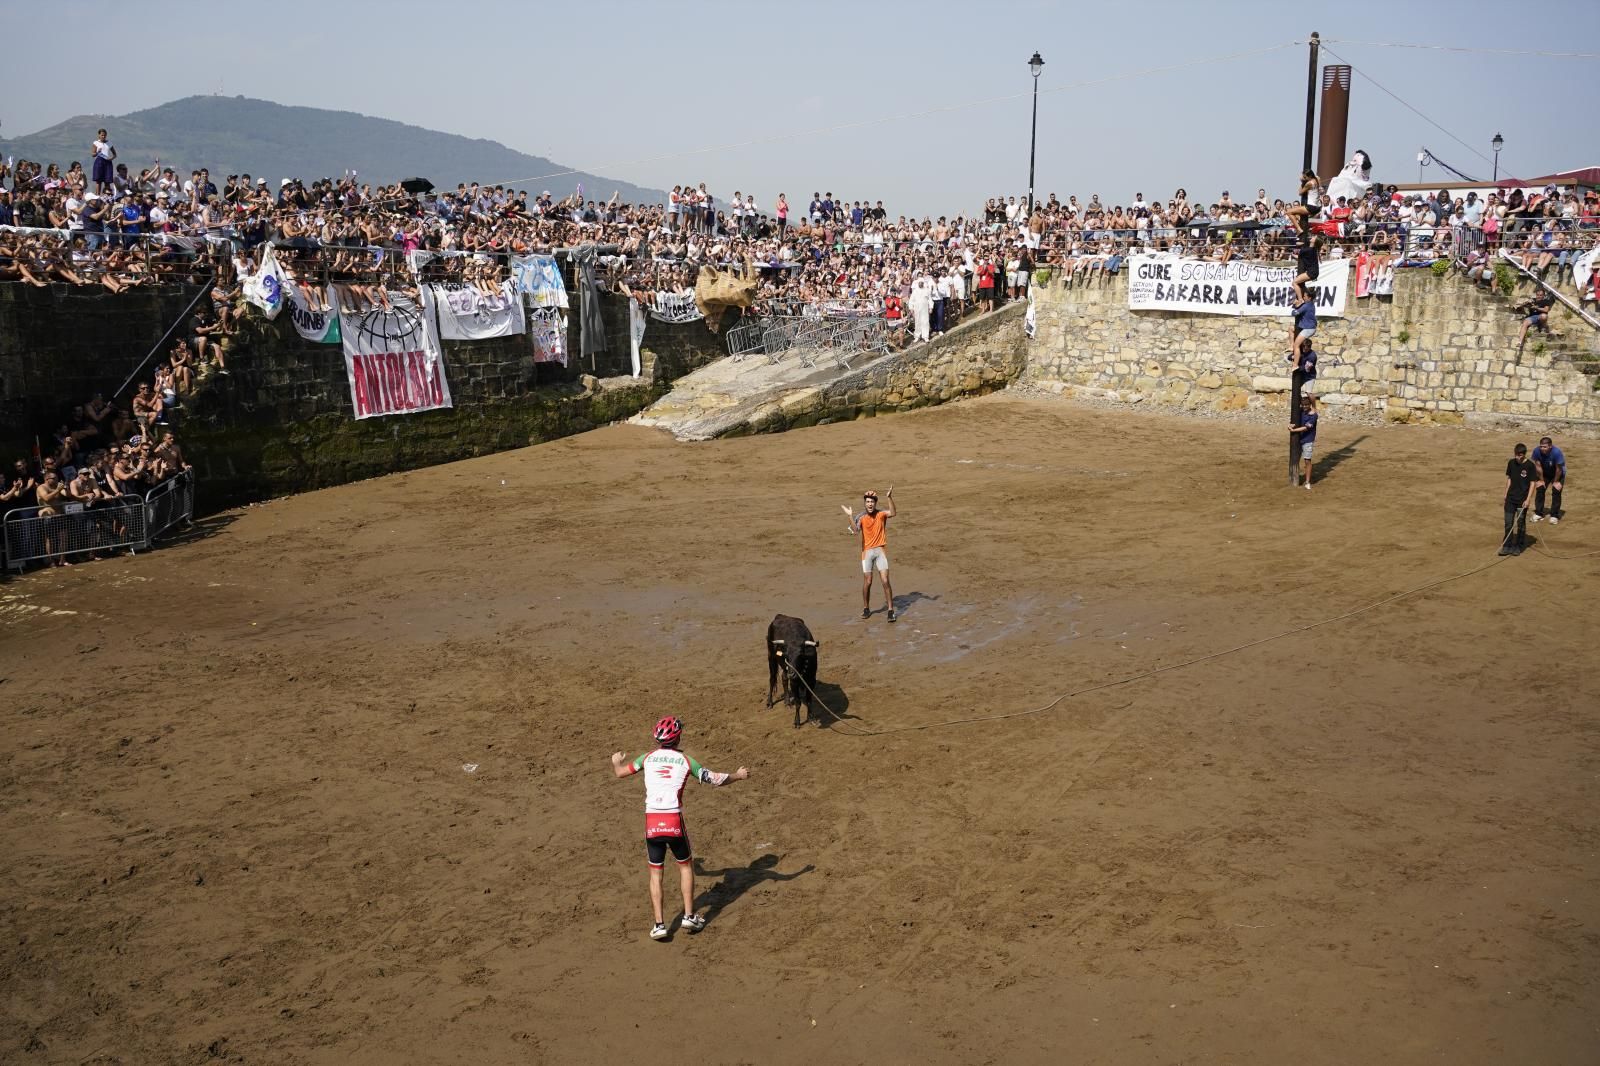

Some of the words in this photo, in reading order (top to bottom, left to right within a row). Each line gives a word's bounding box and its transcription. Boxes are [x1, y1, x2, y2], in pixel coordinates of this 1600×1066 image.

[1138, 263, 1172, 281] GURE
[1154, 282, 1239, 304] BAKARRA
[647, 755, 685, 766] Euskadi
